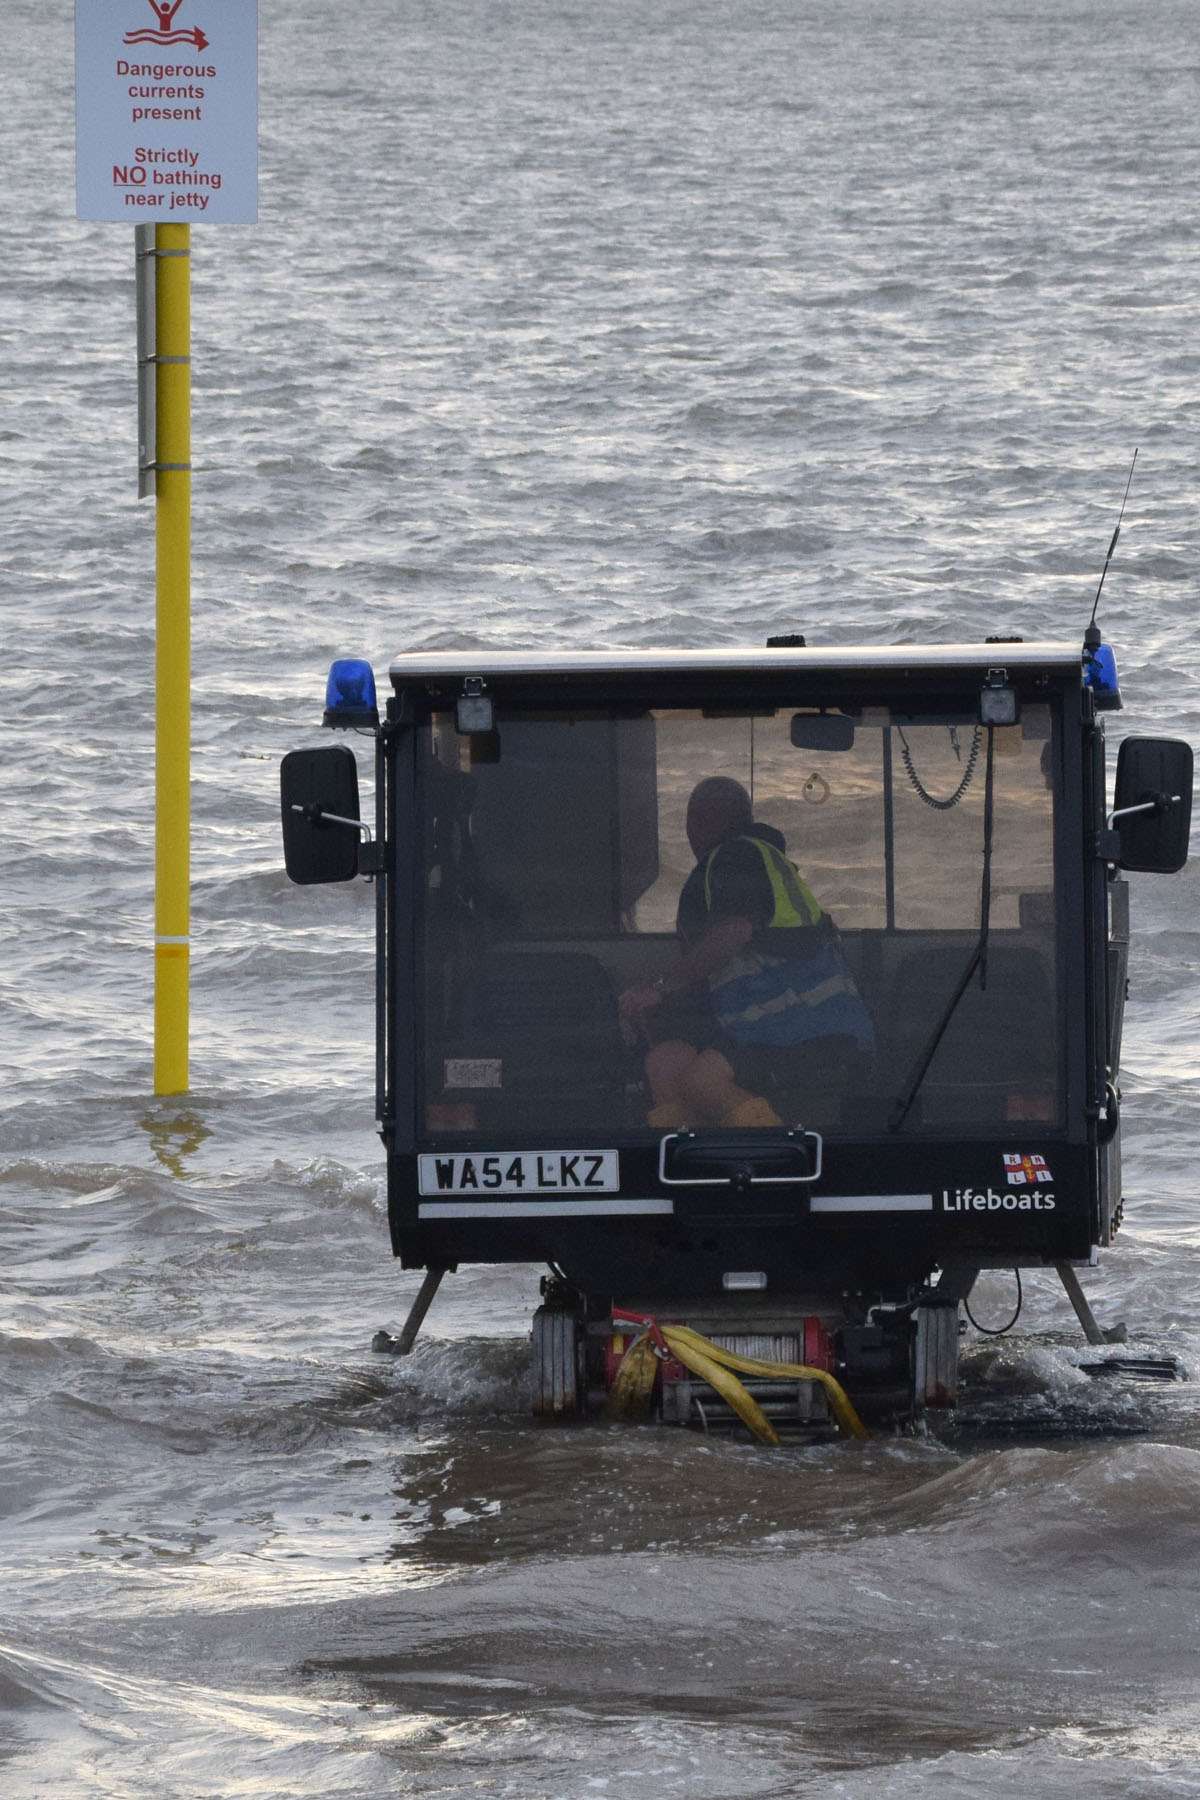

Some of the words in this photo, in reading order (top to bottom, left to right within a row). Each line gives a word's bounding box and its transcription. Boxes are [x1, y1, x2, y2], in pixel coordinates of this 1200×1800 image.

[117, 60, 217, 80] Dangerous
[128, 85, 205, 99] currents
[132, 106, 202, 123] present
[134, 147, 200, 167] Strictly
[112, 165, 147, 186] NO
[153, 170, 222, 189] bathing
[124, 193, 165, 206] near
[169, 191, 210, 210] jetty
[434, 1157, 526, 1189] WA54
[537, 1155, 605, 1188] LKZ
[943, 1188, 1056, 1211] Lifeboats
